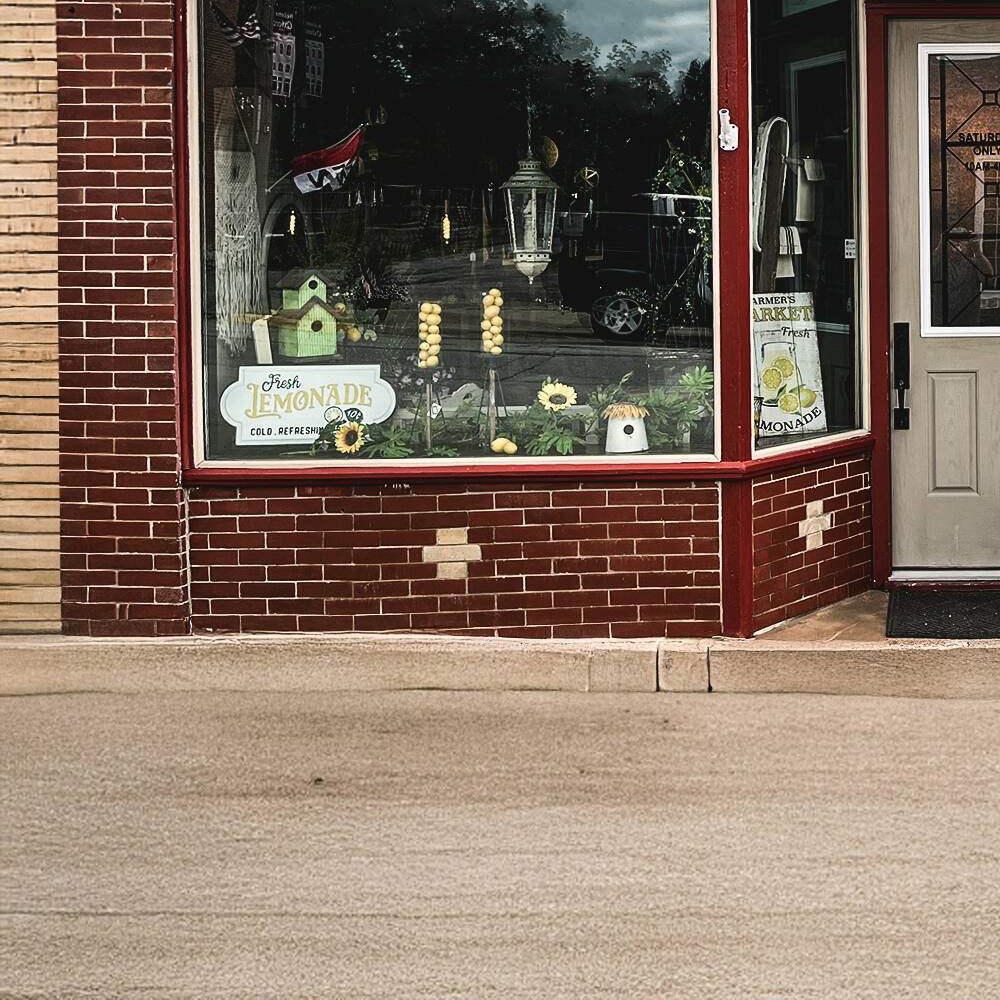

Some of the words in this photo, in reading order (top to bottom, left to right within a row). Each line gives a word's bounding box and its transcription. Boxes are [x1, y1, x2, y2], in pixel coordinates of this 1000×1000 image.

[753, 295, 796, 305] ARMER'S
[753, 305, 813, 322] ARKET
[781, 326, 810, 338] Fresh
[261, 373, 301, 392] Fresh
[245, 383, 372, 419] LEMONADE
[757, 406, 822, 432] MONADE
